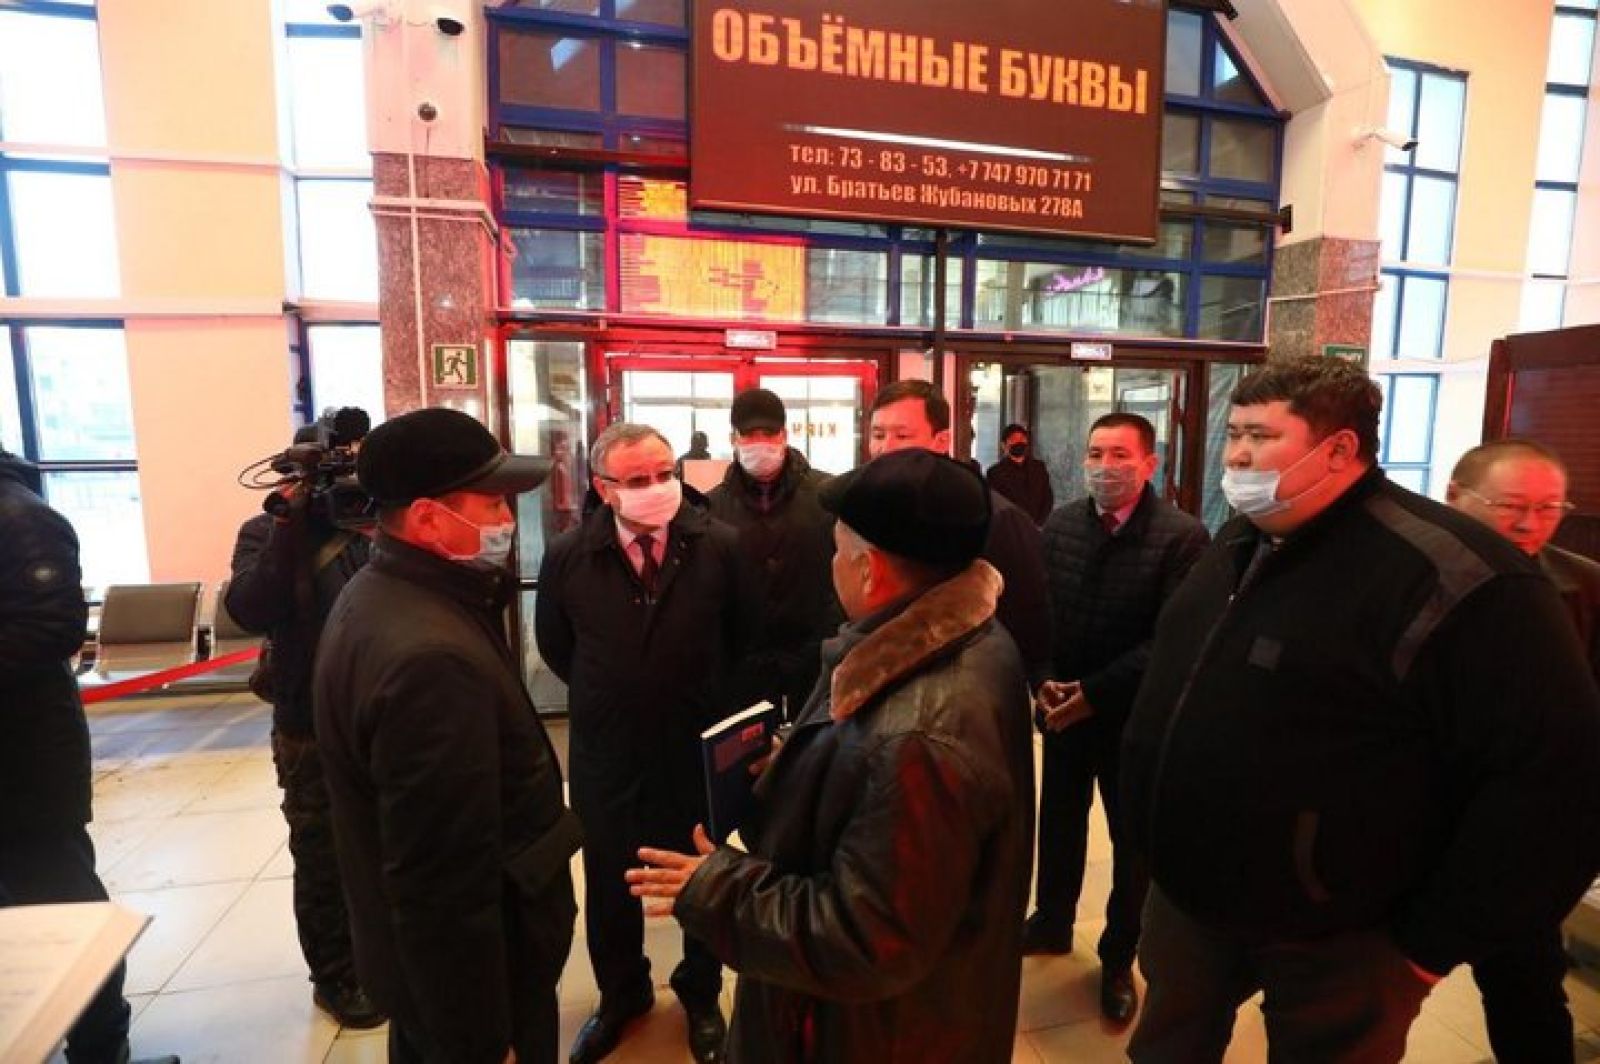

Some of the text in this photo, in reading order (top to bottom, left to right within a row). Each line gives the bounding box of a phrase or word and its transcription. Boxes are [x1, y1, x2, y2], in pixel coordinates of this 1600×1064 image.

[712, 8, 1148, 113] ОБЪЁМНЫЕ БУКВЫ
[790, 144, 834, 165] тел:
[839, 147, 862, 169] 73
[879, 150, 905, 172] 83
[957, 159, 979, 181] +7
[982, 161, 1012, 183] 747
[1015, 165, 1049, 187] 970
[1052, 168, 1070, 189] 71
[1072, 170, 1092, 191] 71
[790, 174, 823, 194] ул.
[827, 175, 917, 202] Братьев
[920, 183, 1037, 213] Жубановых
